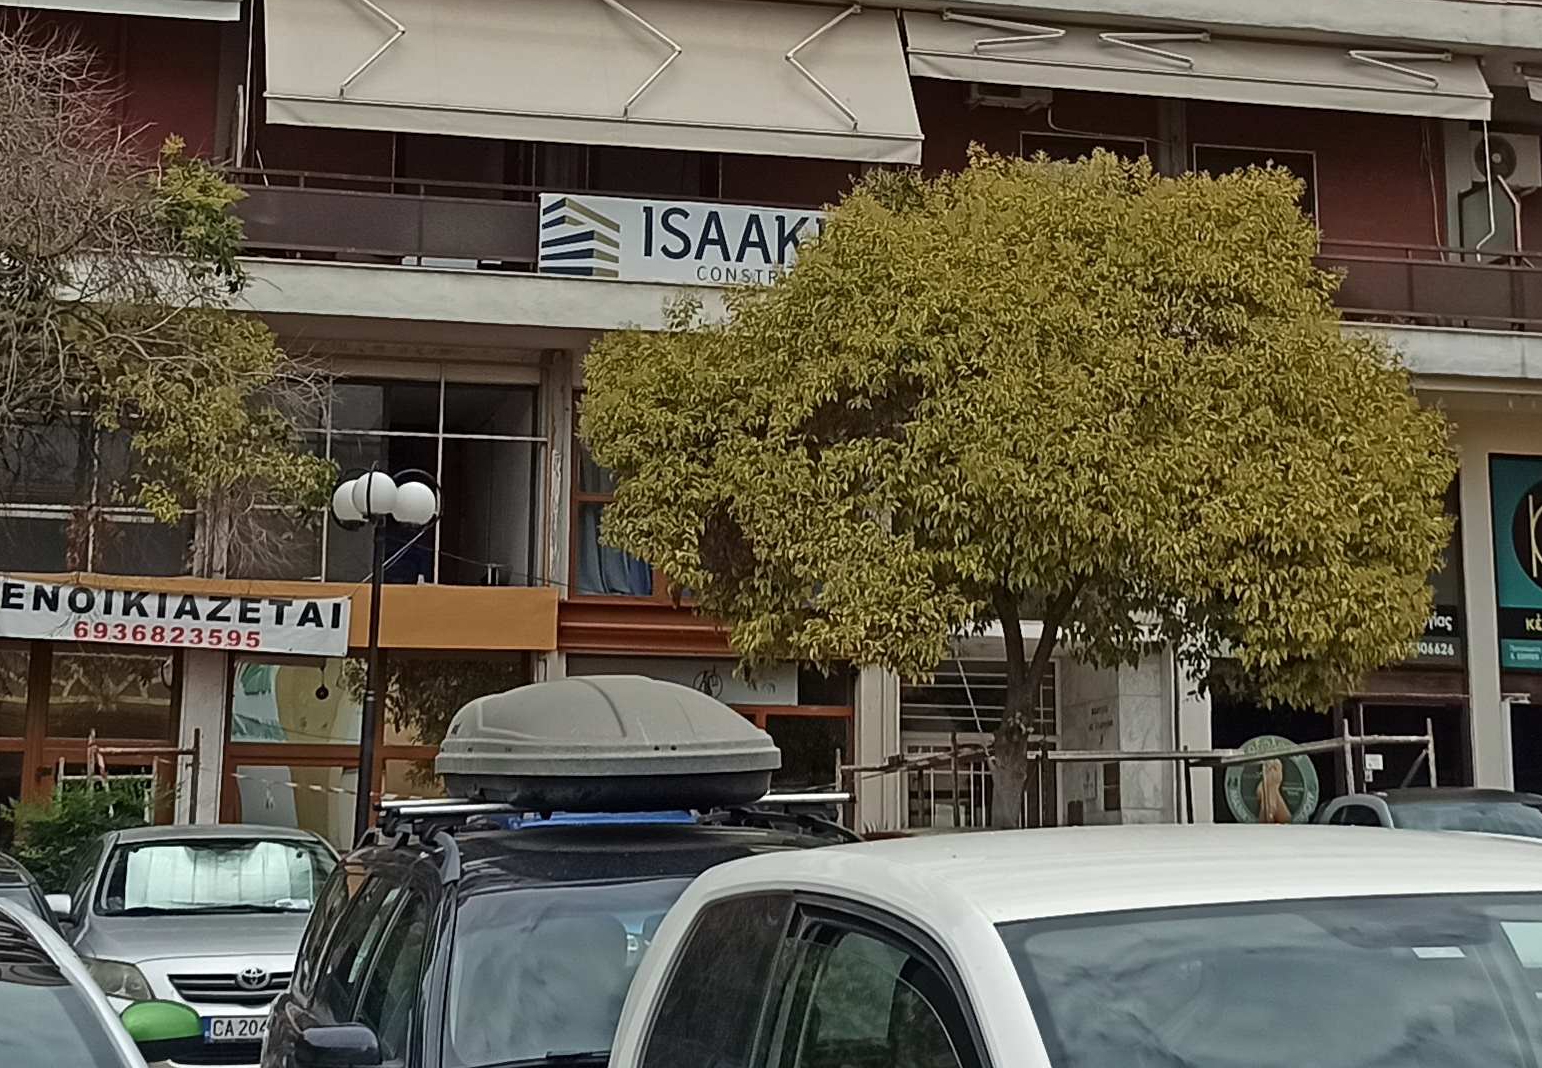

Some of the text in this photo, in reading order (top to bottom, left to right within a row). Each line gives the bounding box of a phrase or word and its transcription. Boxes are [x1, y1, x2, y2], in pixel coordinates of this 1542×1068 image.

[1, 582, 341, 629] ΕΝΟΙΚΙΑΖΕΤΑΙ
[74, 621, 261, 649] 6936823595
[213, 1019, 235, 1037] CA
